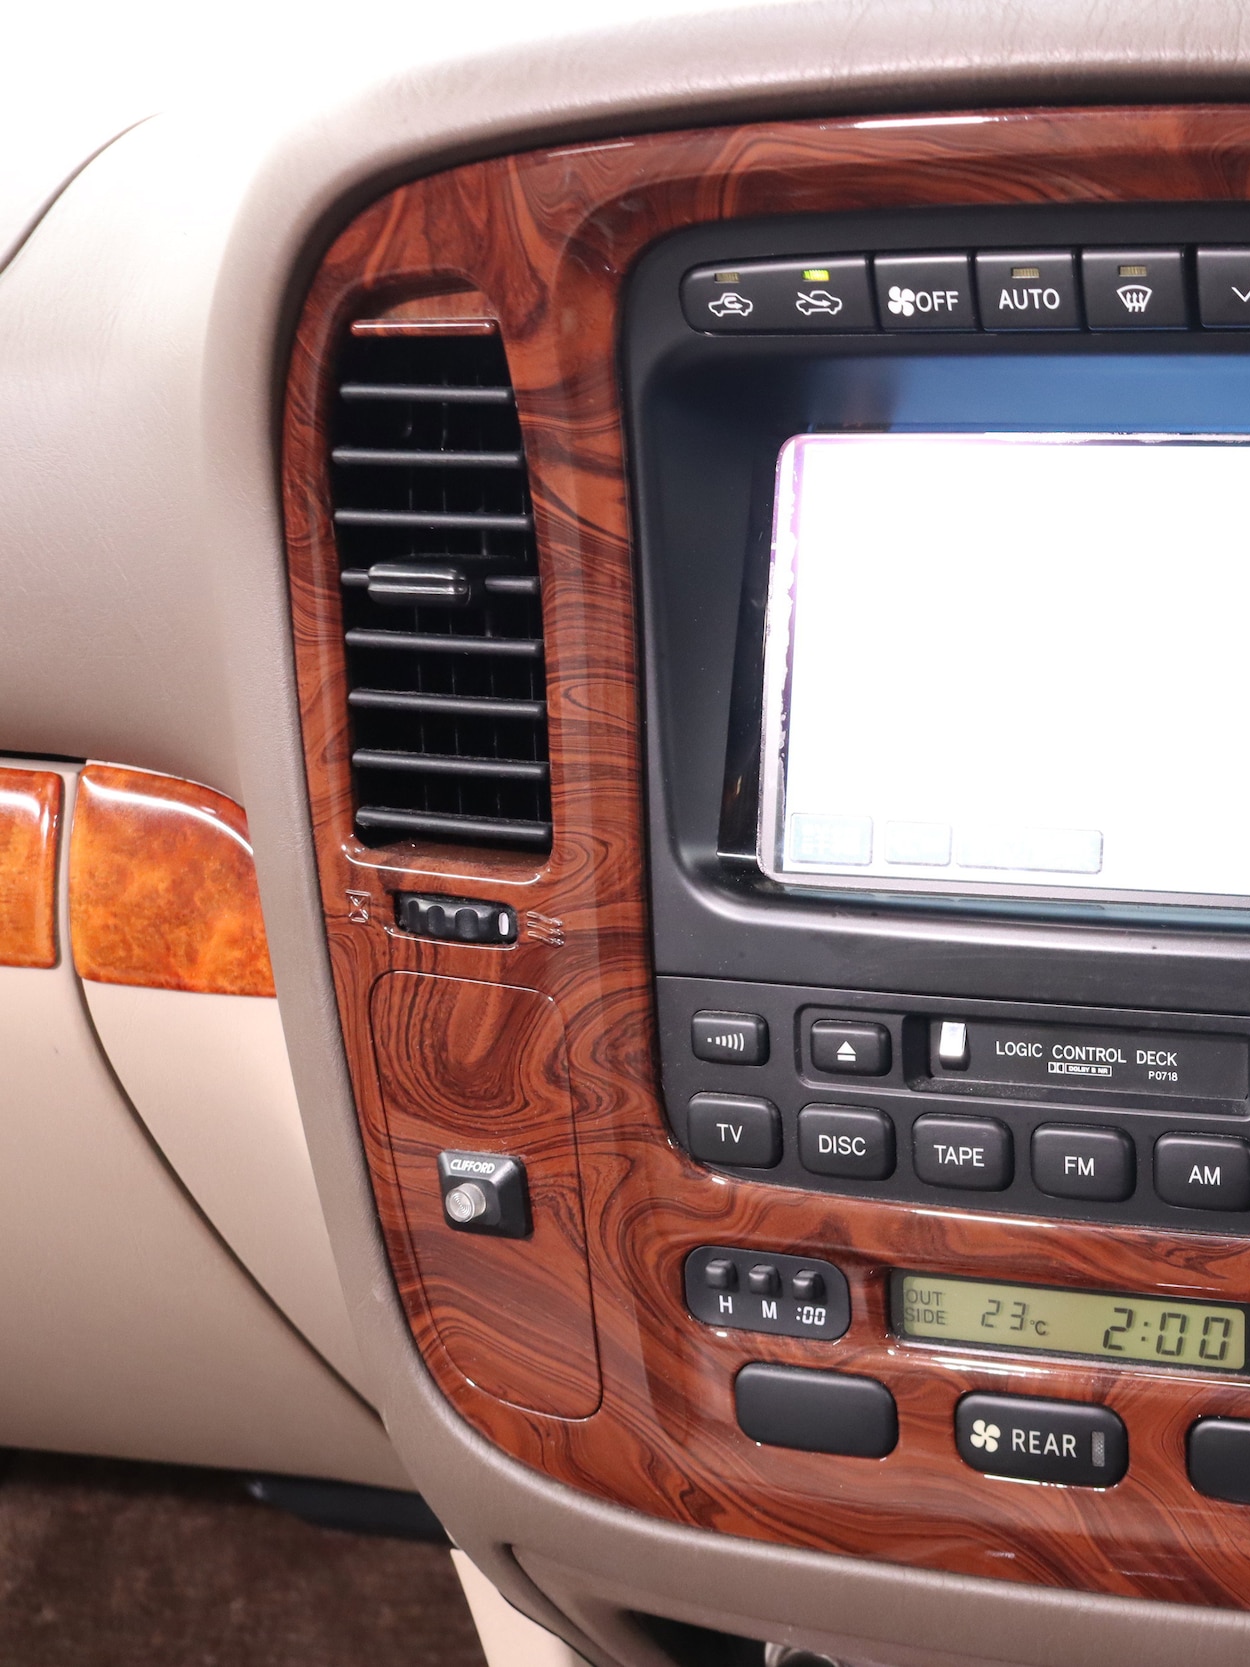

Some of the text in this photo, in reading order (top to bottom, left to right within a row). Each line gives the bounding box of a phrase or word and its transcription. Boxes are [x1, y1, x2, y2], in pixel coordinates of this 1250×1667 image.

[915, 289, 959, 313] OFF
[998, 287, 1061, 311] AUTO
[996, 1041, 1178, 1066] LOGIC CONTROL DECK
[1068, 1065, 1090, 1073] DOLBY
[1148, 1071, 1178, 1082] P0718
[716, 1123, 743, 1143] TV
[818, 1134, 867, 1156] DISC
[450, 1159, 496, 1174] CLIFFORD
[933, 1145, 985, 1168] TAPE
[1064, 1156, 1095, 1177] FM
[1188, 1165, 1222, 1186] AM
[719, 1296, 732, 1314] H
[762, 1302, 778, 1320] M
[906, 1289, 943, 1307] OUT
[905, 1306, 945, 1326] SIDE
[1103, 1307, 1230, 1361] 2:00
[1012, 1428, 1077, 1458] REAR
